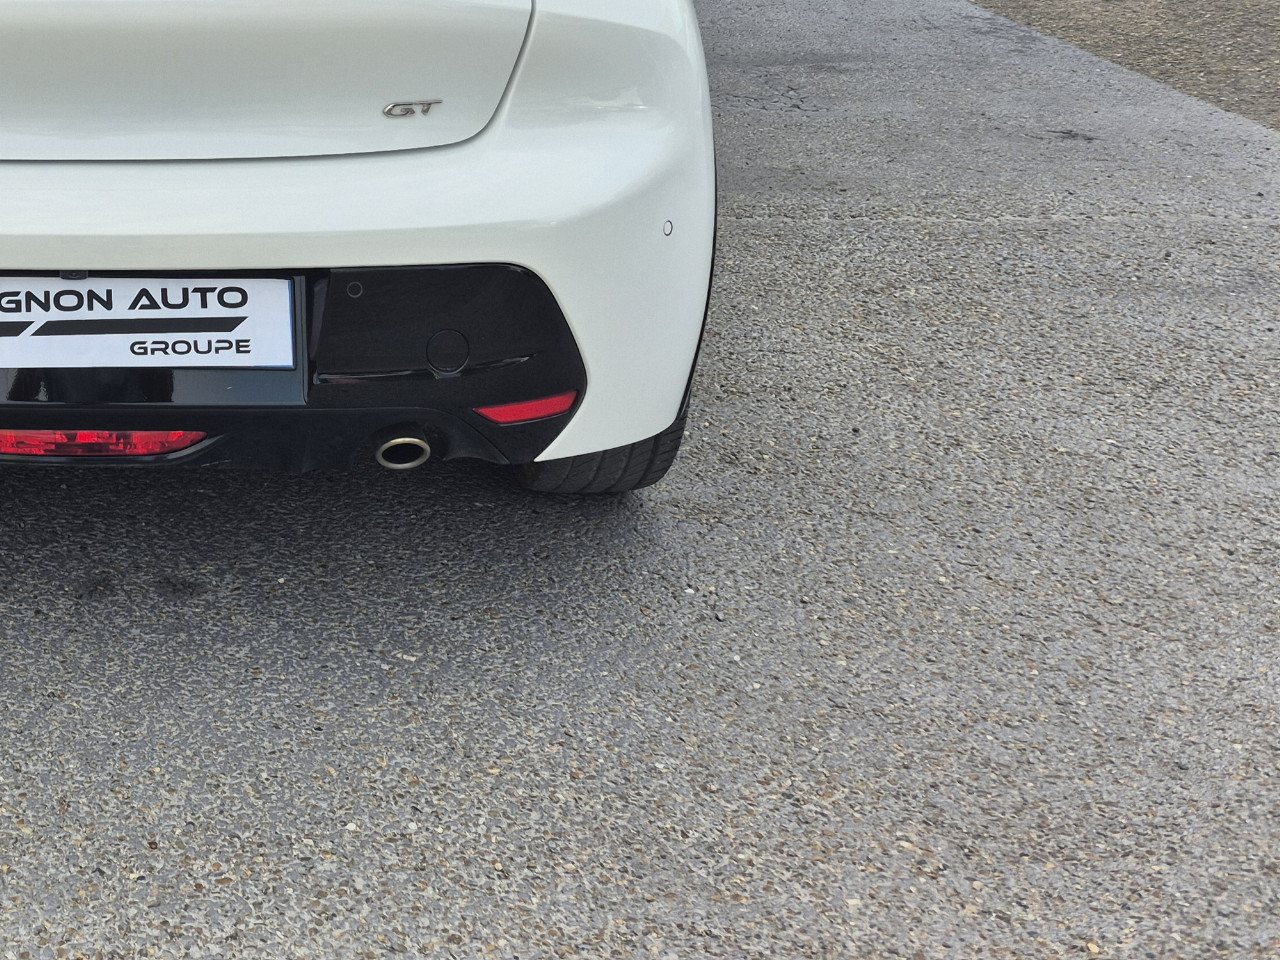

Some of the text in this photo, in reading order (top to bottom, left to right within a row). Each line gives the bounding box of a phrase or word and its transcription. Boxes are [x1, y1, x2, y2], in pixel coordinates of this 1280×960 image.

[382, 99, 443, 118] GT
[128, 286, 249, 311] AUTO
[129, 339, 252, 356] GROUPE
